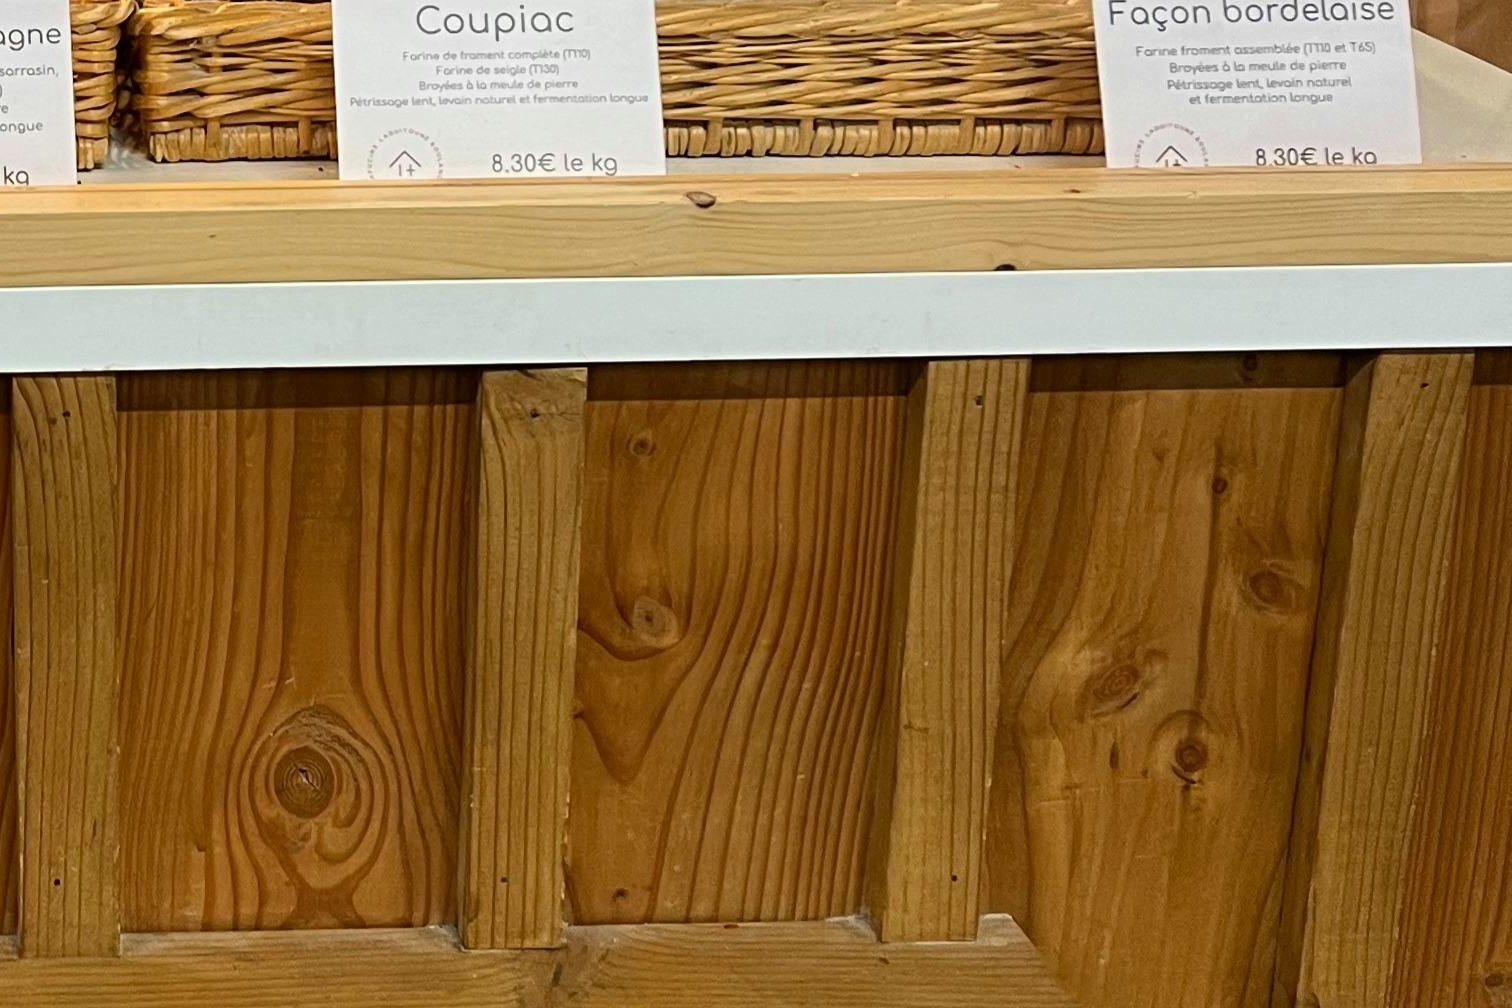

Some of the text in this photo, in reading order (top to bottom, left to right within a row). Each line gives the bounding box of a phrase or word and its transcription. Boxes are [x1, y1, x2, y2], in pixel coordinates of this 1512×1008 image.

[416, 4, 573, 42] Coupiac
[1109, 0, 1211, 32] Façon
[403, 51, 440, 61] Farine
[443, 50, 458, 60] de
[1136, 46, 1177, 56] Farine
[1181, 45, 1231, 56] froment
[1234, 42, 1301, 55] assemblée
[1334, 43, 1347, 53] et
[436, 65, 473, 75] Farine
[476, 65, 491, 75] de
[1222, 61, 1231, 72] à
[1233, 61, 1245, 72] la
[1248, 60, 1286, 72] meule
[1290, 59, 1306, 71] de
[1309, 60, 1346, 73] pierre
[466, 79, 474, 90] à
[476, 80, 487, 90] la
[490, 79, 524, 90] meule
[526, 79, 541, 90] de
[545, 79, 578, 91] pierre
[1167, 79, 1233, 92] Pétrissage
[1266, 77, 1303, 88] levain
[1305, 76, 1352, 88] naturel
[350, 97, 408, 108] Pétrissage
[438, 96, 472, 105] levain
[475, 94, 516, 104] naturel
[519, 94, 530, 104] et
[533, 94, 607, 104] fermentation
[609, 93, 648, 104] longue
[1189, 92, 1333, 105] et fermentation longue
[1325, 147, 1344, 166] le
[492, 153, 617, 176] 8.30€ le kg
